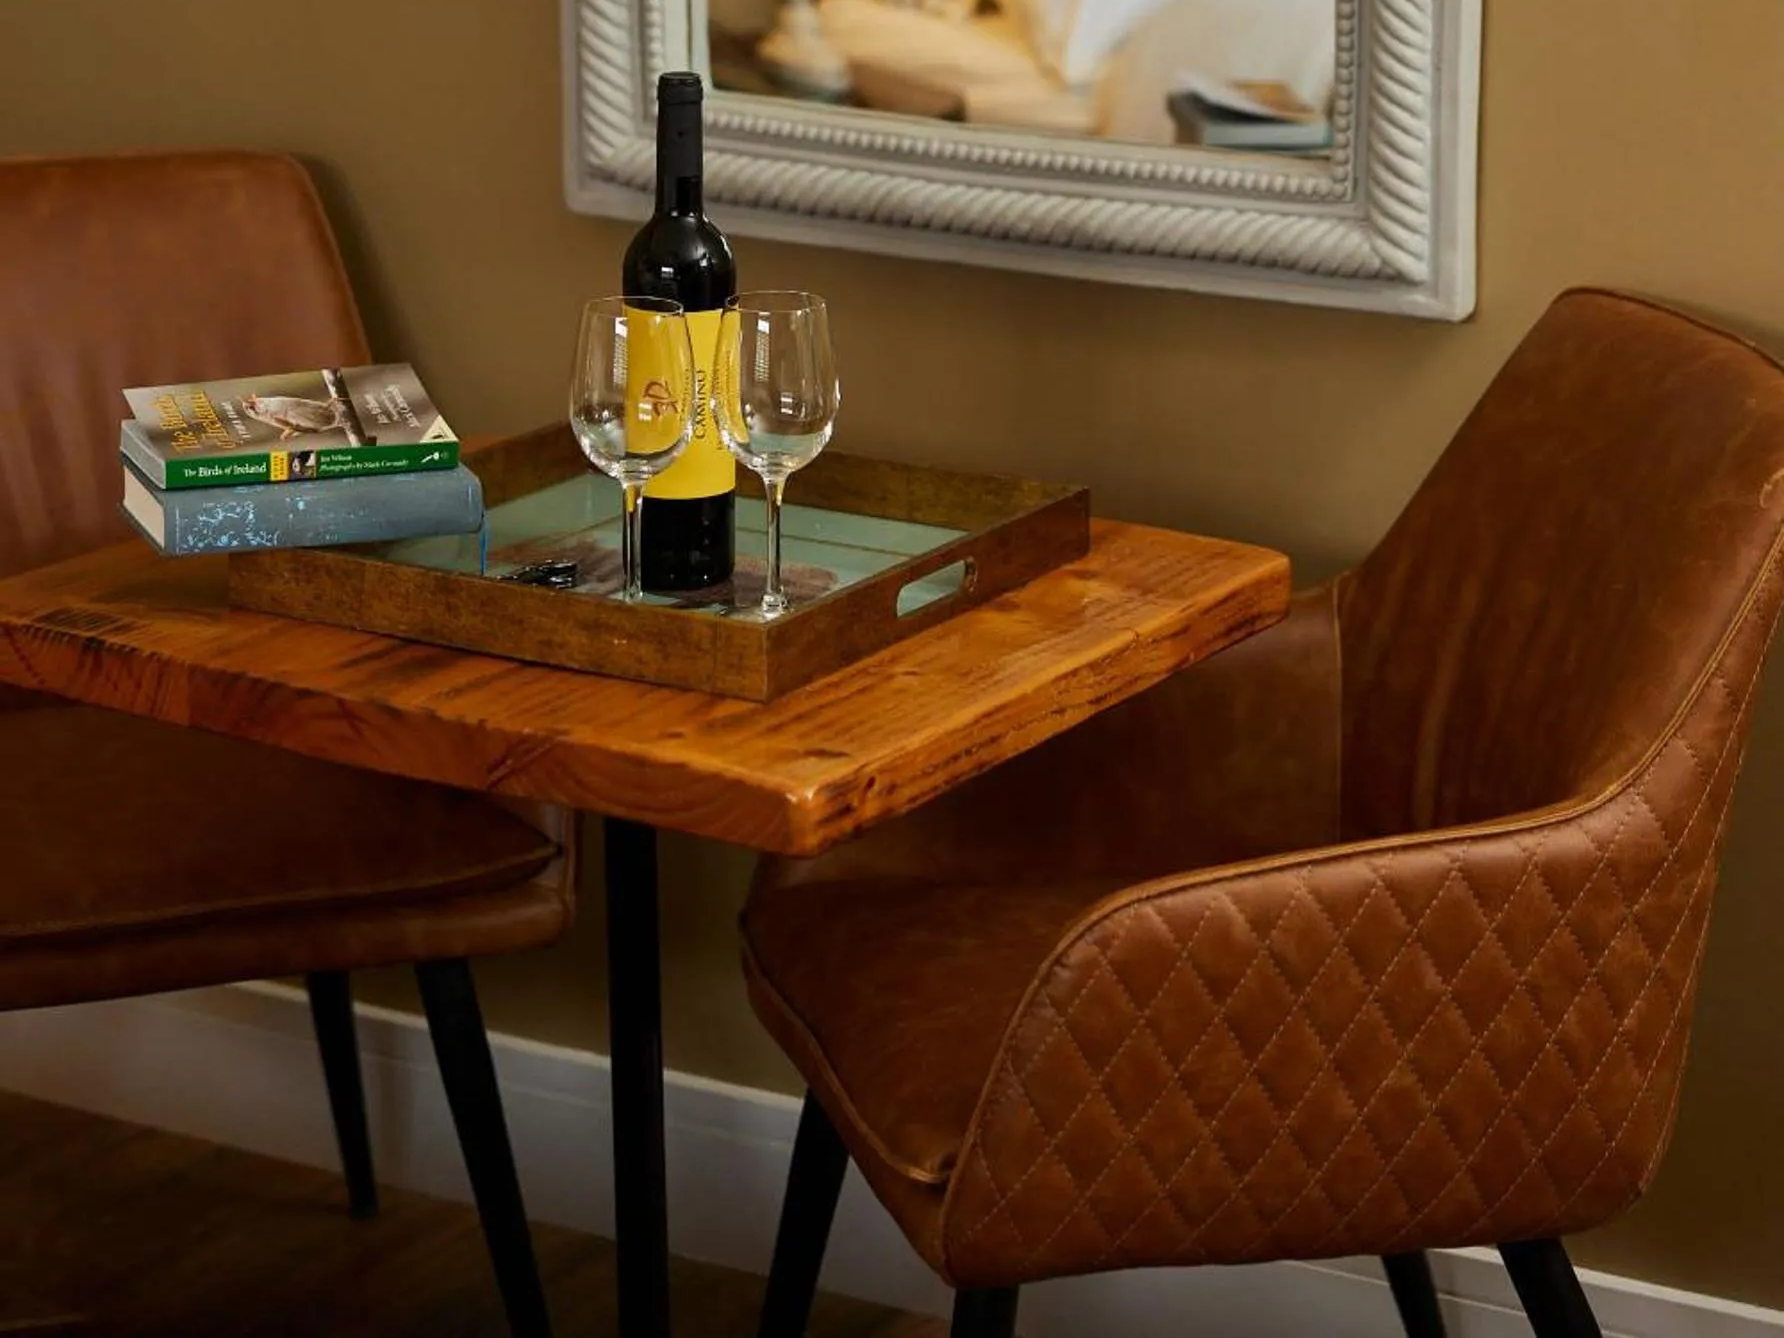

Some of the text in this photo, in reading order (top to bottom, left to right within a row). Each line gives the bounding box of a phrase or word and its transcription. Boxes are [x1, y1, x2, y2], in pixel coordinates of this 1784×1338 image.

[183, 468, 198, 478] The
[198, 465, 223, 478] Birds
[224, 464, 233, 475] of
[233, 462, 267, 475] Ireland
